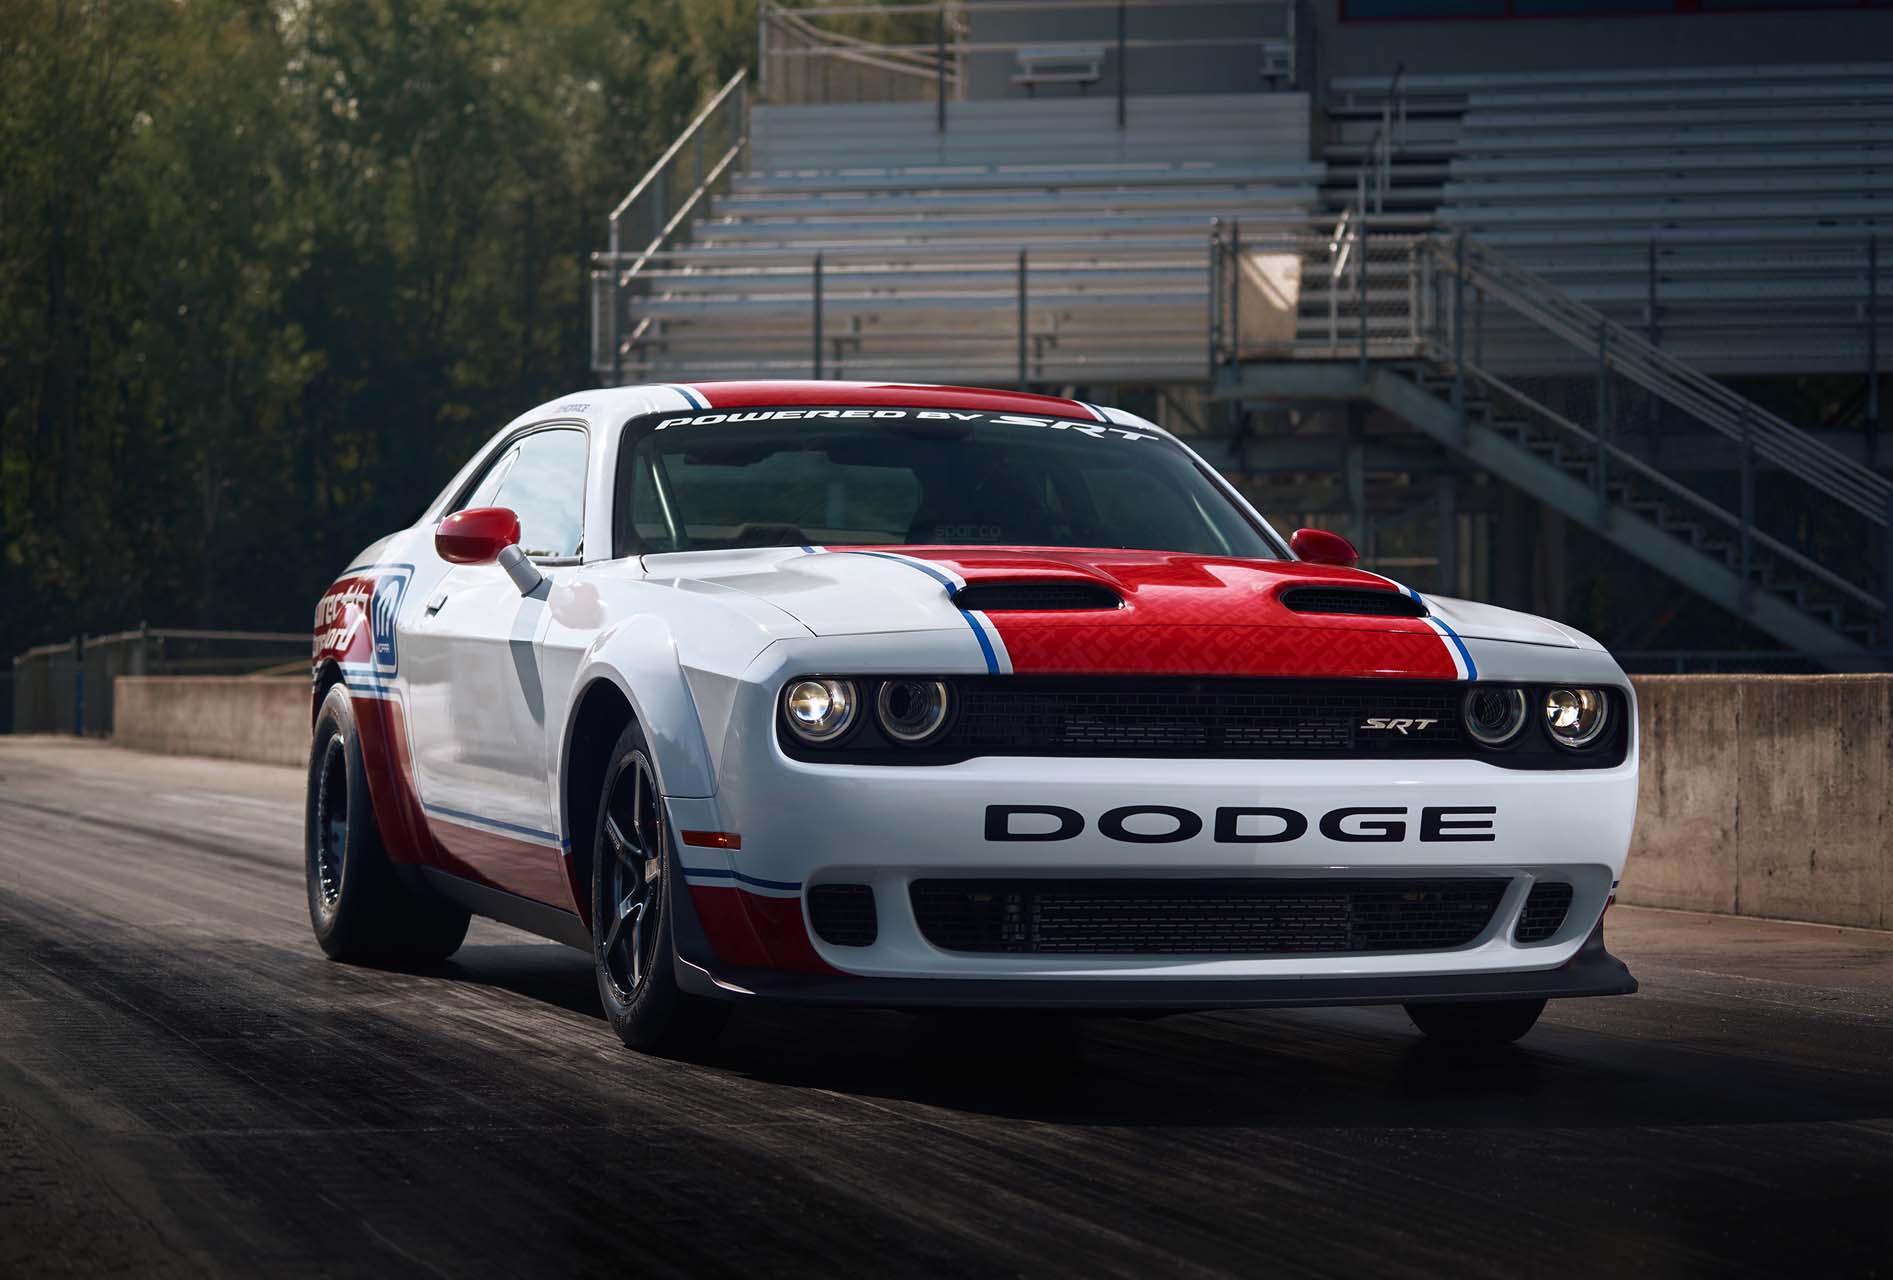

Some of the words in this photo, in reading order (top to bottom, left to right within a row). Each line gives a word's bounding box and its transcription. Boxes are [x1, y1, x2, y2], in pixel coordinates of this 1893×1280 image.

[655, 410, 907, 431] POWERED
[916, 411, 984, 421] BY
[989, 415, 1159, 441] SRT
[935, 525, 1001, 538] sparco
[1360, 717, 1439, 735] SRT
[984, 805, 1496, 843] DODGE
